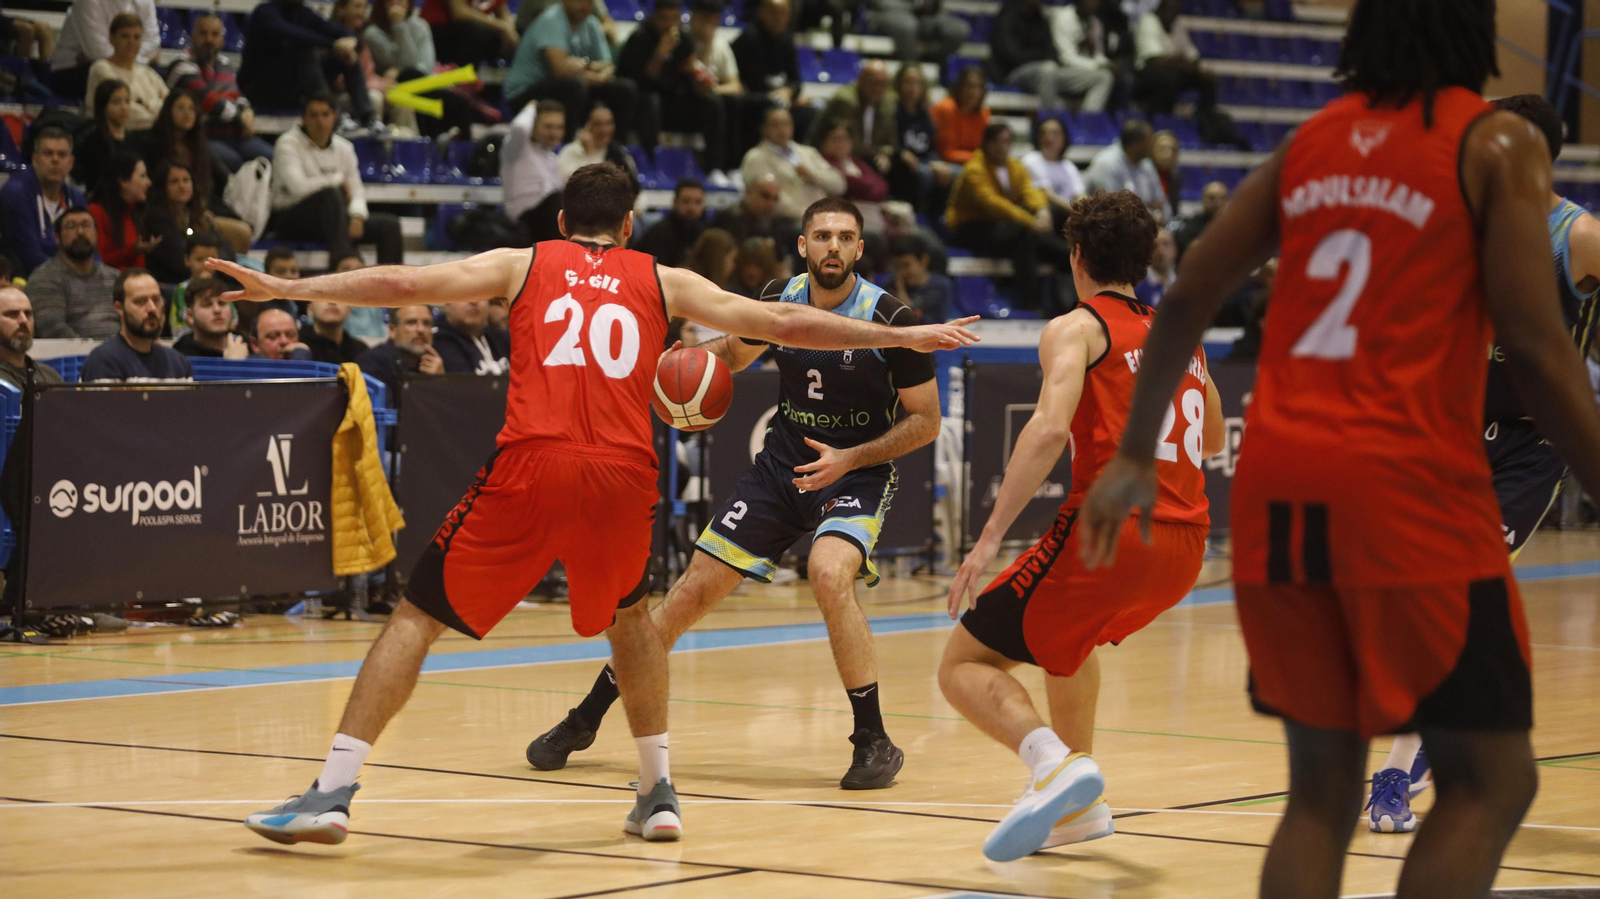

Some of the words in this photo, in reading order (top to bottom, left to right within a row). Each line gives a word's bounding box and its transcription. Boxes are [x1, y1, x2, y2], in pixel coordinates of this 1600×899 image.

[588, 274, 621, 294] GIL
[1290, 228, 1372, 360] 2
[542, 292, 640, 379] 20
[806, 368, 824, 400] 2
[1153, 388, 1204, 470] 28
[83, 465, 202, 526] surpool
[175, 513, 202, 525] SERVICE
[237, 501, 325, 534] LABOR
[721, 500, 748, 530] 2
